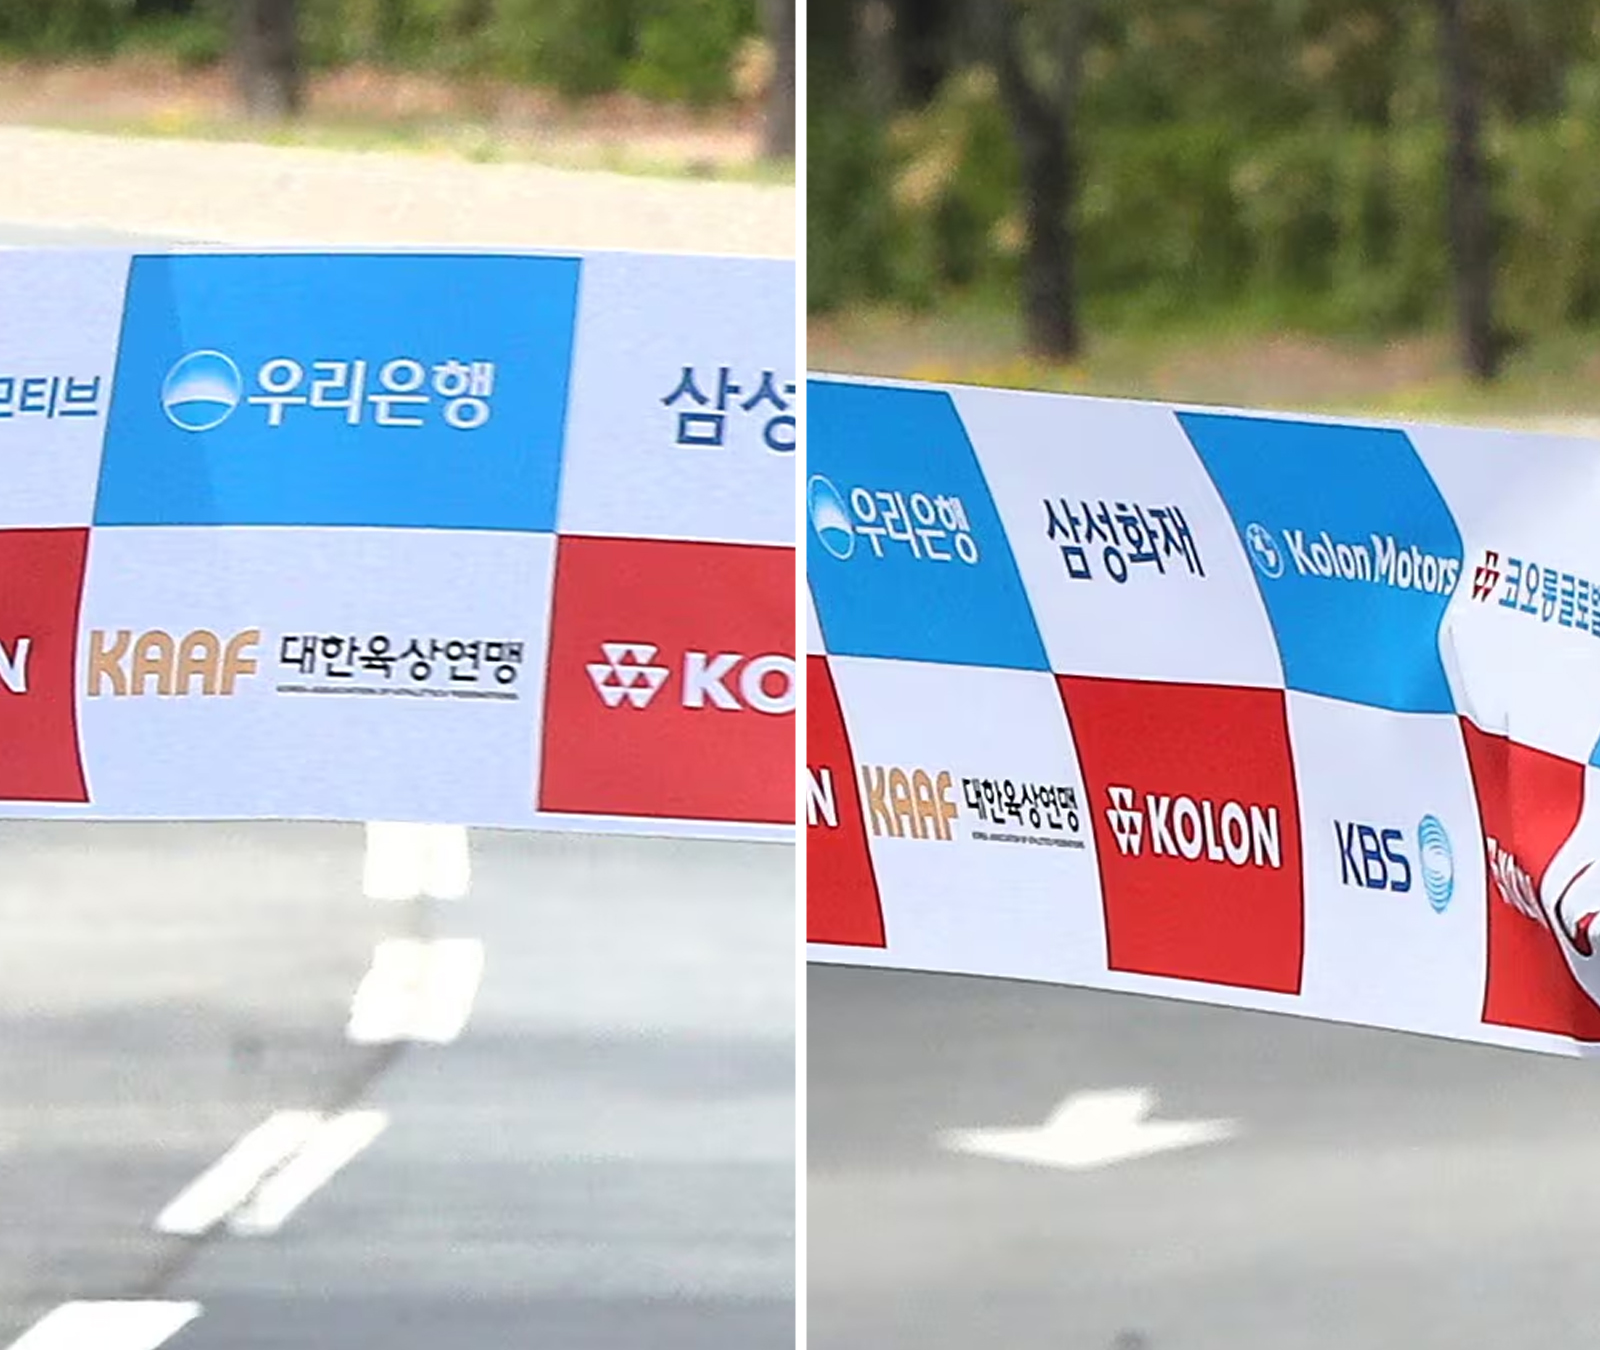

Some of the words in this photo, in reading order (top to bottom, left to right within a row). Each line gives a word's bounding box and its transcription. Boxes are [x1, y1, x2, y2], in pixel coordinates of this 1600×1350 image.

[247, 358, 496, 430] 우리은행
[850, 486, 980, 566] 우리은행
[1042, 497, 1206, 585] 삼성화재
[1283, 528, 1371, 582] Kolon
[1369, 532, 1460, 596] Motors
[86, 629, 261, 697] KAAF
[279, 634, 525, 685] 대한육상연맹
[861, 764, 959, 841] KAAF
[961, 776, 1080, 833] 대한육상연맹
[1146, 794, 1282, 870] KOLON
[1333, 819, 1412, 893] KBS
